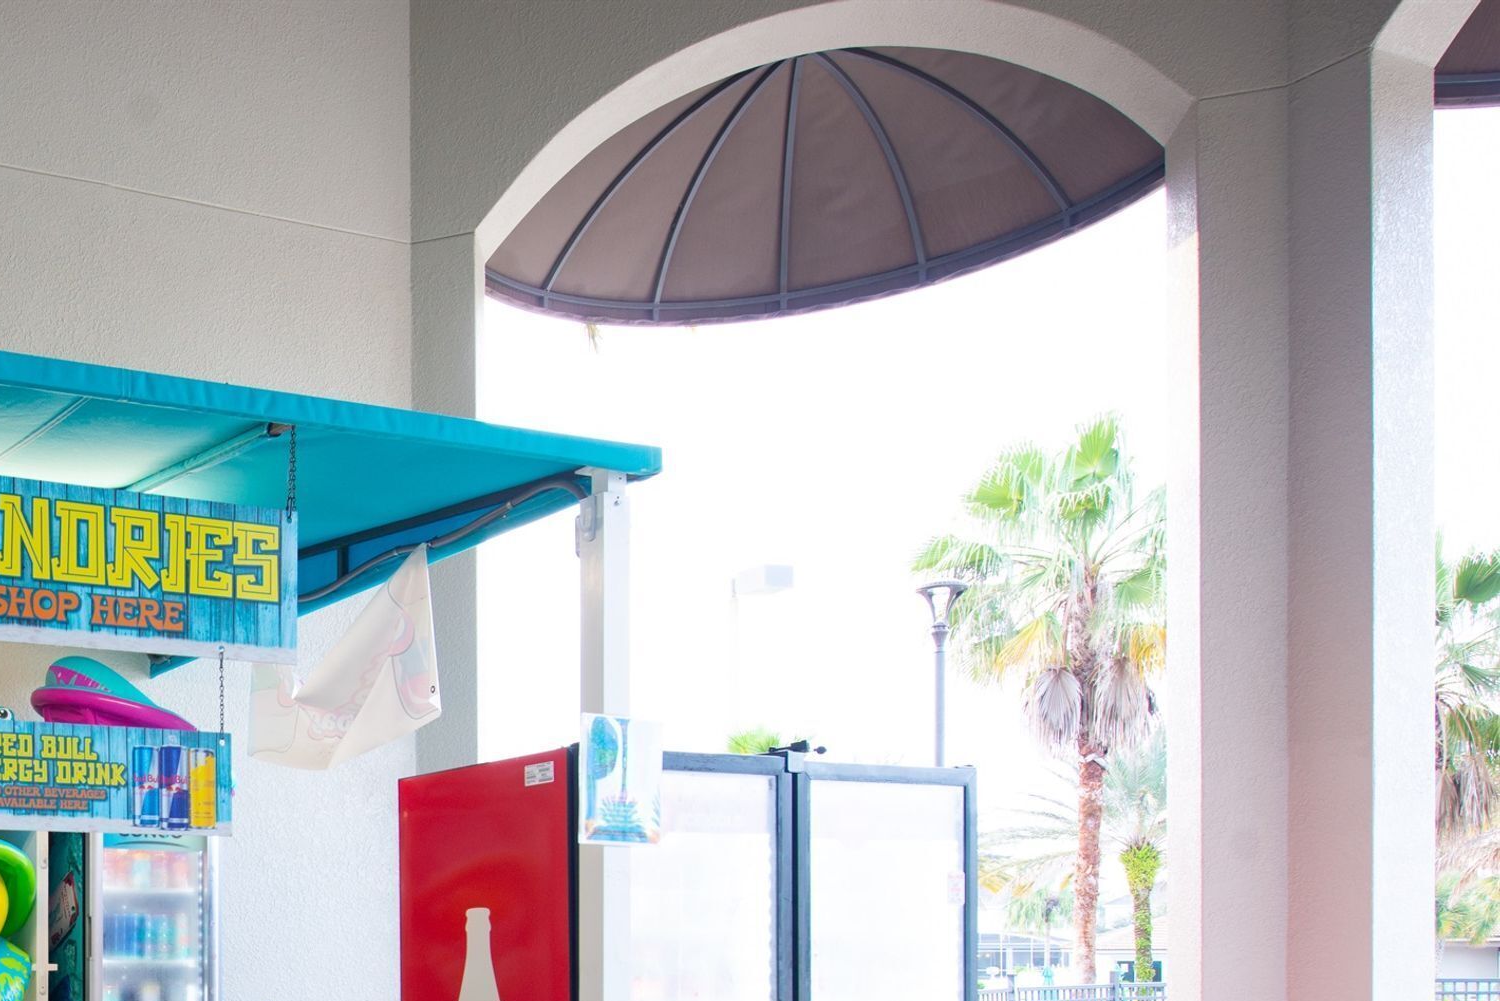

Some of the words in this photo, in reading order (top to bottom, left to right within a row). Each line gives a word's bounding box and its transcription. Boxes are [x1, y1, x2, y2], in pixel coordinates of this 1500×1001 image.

[90, 594, 184, 632] HERE
[41, 735, 98, 761] BULL
[55, 760, 126, 786] DRINK
[4, 785, 41, 797] OTHER
[44, 787, 106, 800] BEVERAGES
[60, 799, 88, 809] HERE
